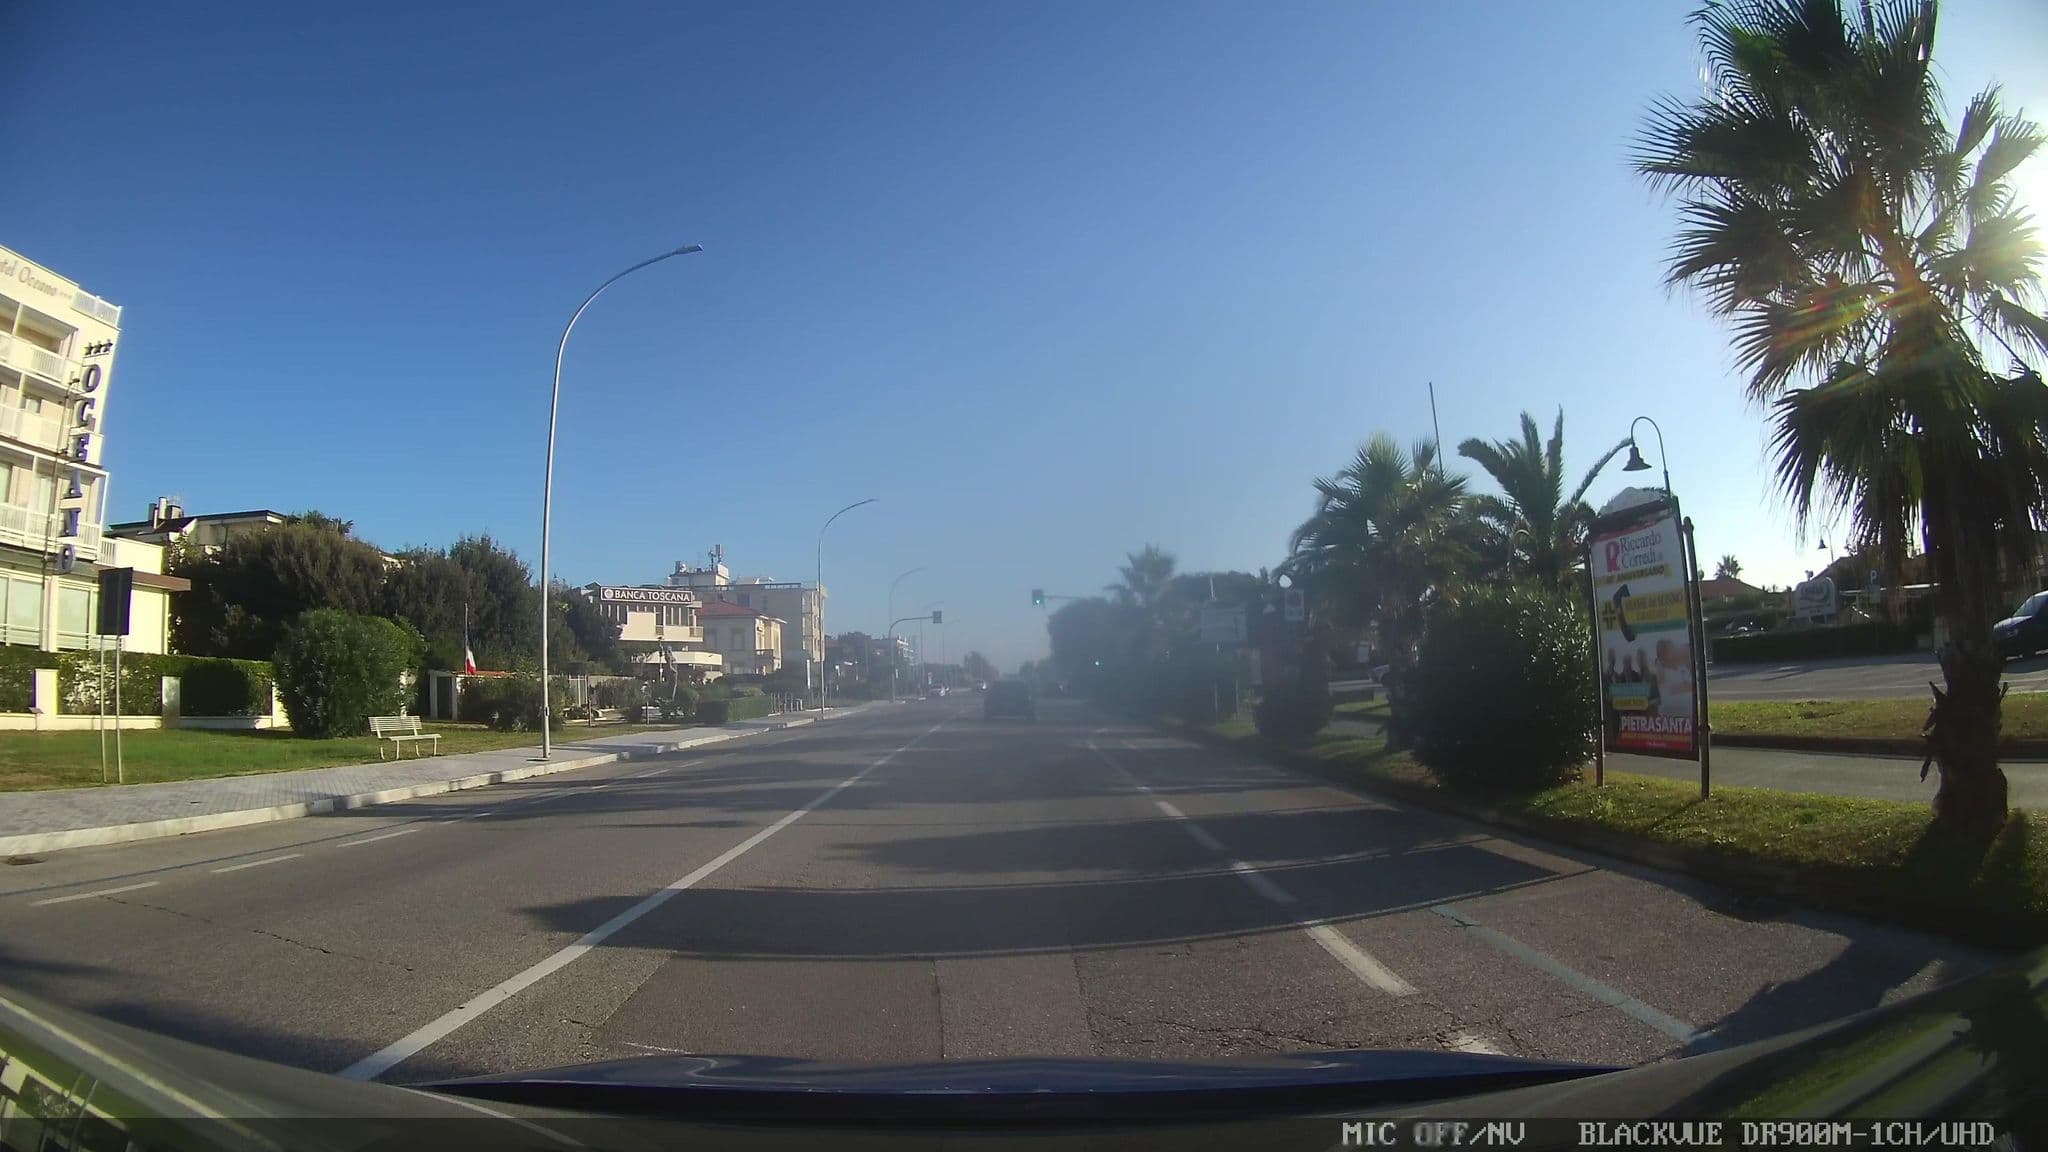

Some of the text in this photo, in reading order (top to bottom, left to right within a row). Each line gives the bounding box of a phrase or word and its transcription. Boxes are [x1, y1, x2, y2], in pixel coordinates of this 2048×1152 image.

[614, 590, 690, 602] BANCA TOSCANA
[1621, 715, 1692, 734] PIETRASANTA
